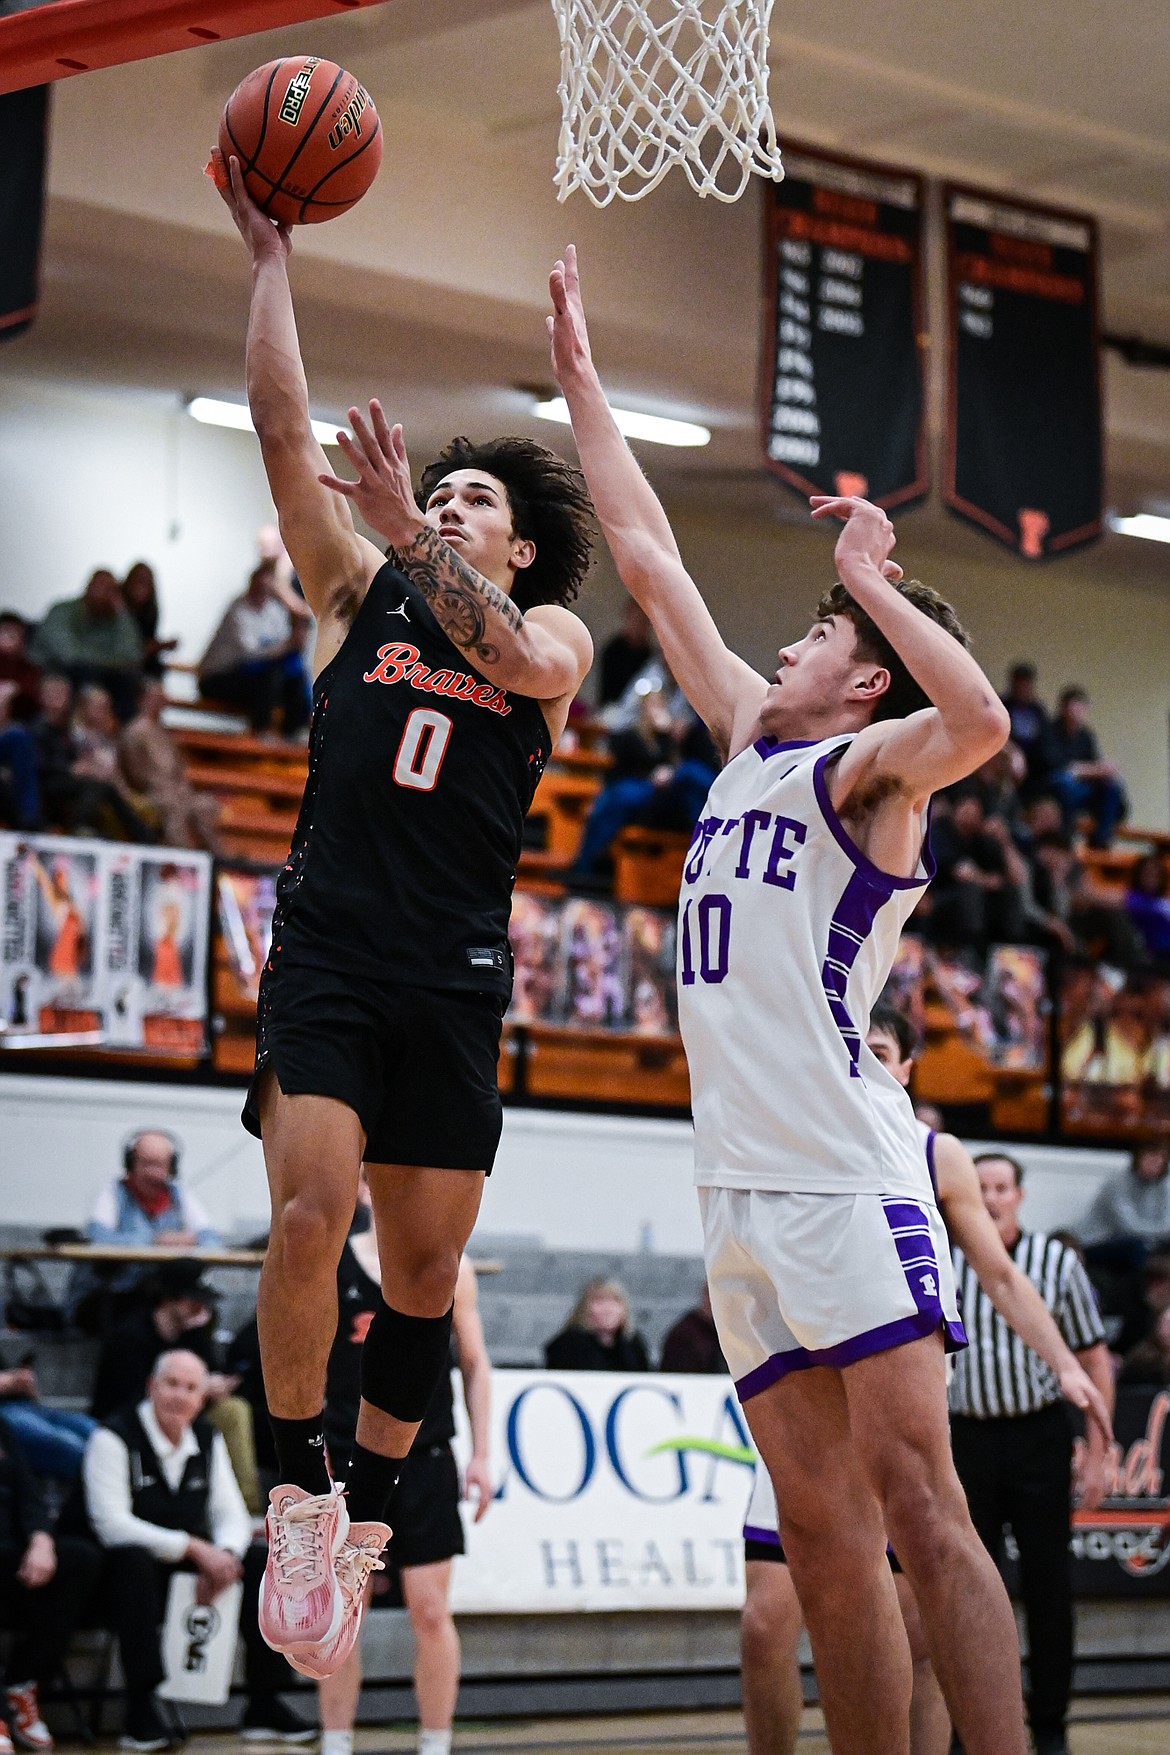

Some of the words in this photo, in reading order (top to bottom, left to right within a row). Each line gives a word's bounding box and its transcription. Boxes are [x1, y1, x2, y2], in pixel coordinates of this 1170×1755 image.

[328, 83, 373, 150] aden
[363, 642, 513, 717] Braves
[392, 706, 454, 792] 0
[684, 808, 808, 892] UTE
[682, 893, 734, 986] 10
[492, 1381, 757, 1506] OGA
